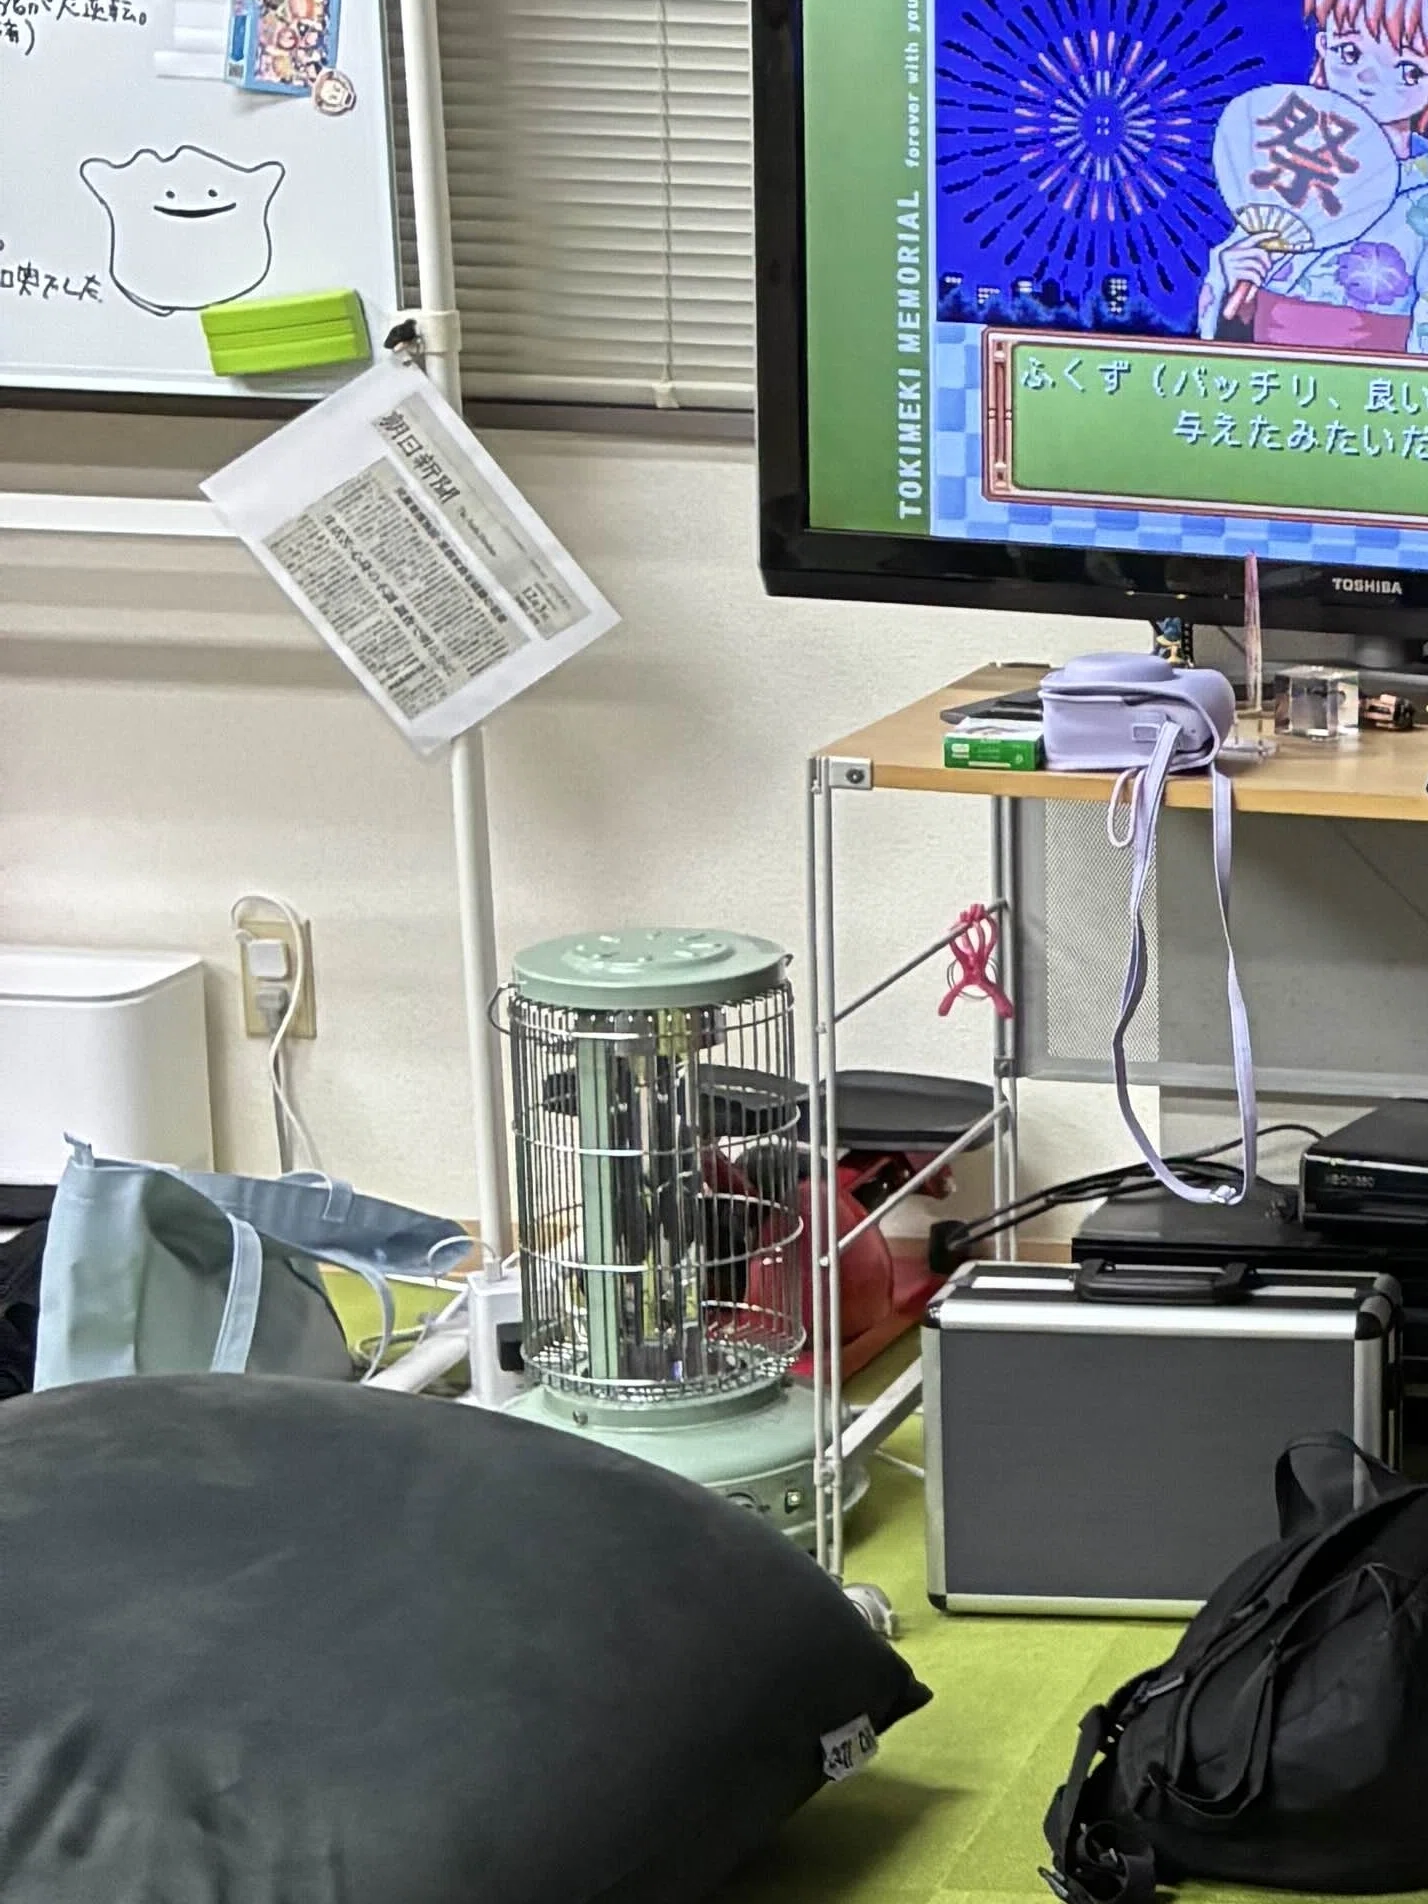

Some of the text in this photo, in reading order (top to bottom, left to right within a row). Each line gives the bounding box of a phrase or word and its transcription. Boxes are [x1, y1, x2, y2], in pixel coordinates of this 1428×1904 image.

[904, 41, 920, 84] with
[904, 92, 921, 168] forever
[1248, 90, 1361, 217] 祭
[897, 190, 922, 353] MEMORIAL
[377, 410, 462, 503] 朝日新聞
[898, 367, 923, 520] TOKIMEKI
[1331, 577, 1403, 595] TOSHIBA
